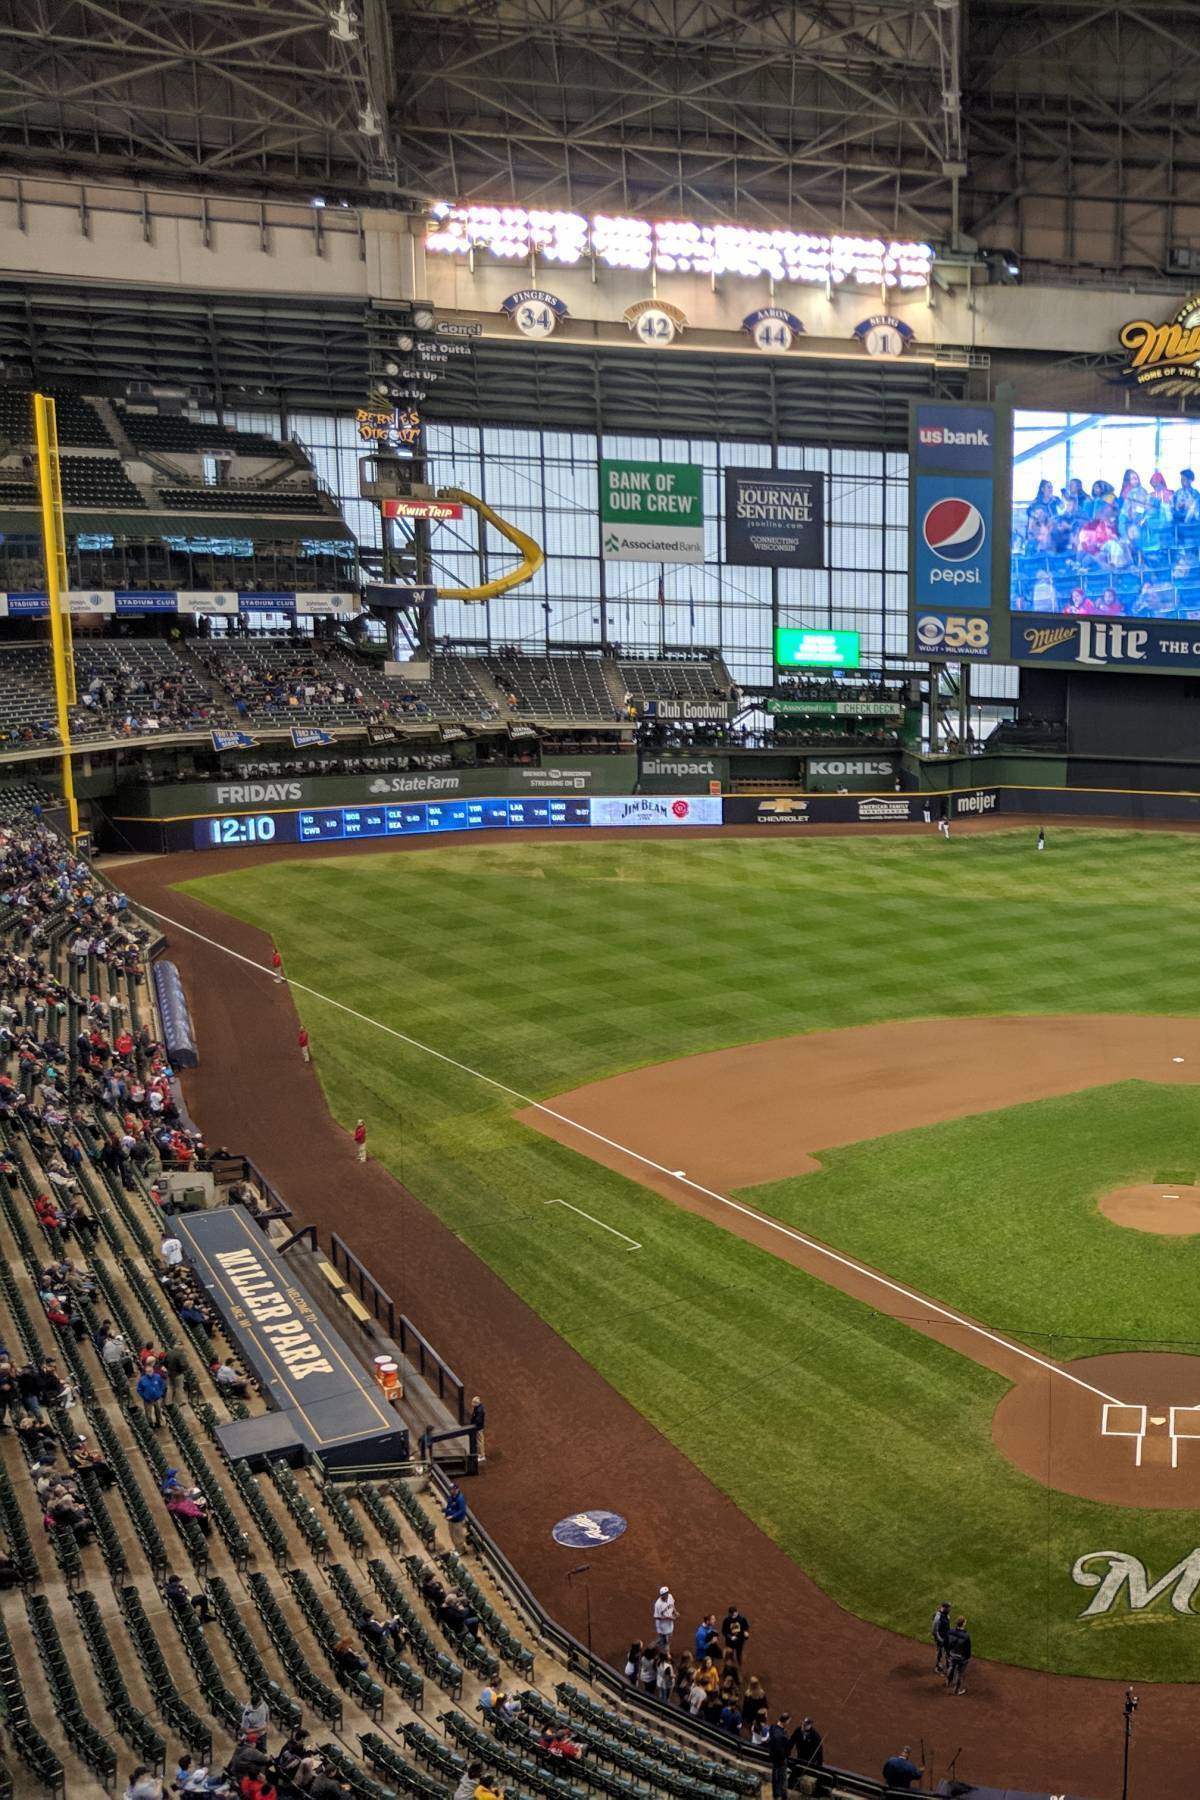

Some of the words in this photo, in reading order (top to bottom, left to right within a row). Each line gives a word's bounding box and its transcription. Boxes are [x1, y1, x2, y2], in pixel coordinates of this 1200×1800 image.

[513, 291, 557, 306] FINGERS
[520, 308, 551, 331] 34
[757, 310, 790, 321] AARON
[870, 316, 898, 328] SELIG
[437, 323, 482, 336] Gone!
[641, 317, 669, 337] 42
[759, 326, 787, 347] 44
[879, 335, 890, 353] 1
[417, 343, 437, 352] Get
[440, 343, 471, 355] Outta
[422, 353, 448, 362] Here
[402, 371, 421, 380] Get
[423, 371, 438, 381] Up
[1138, 369, 1162, 384] HOME
[1164, 367, 1175, 376] OF
[1179, 367, 1195, 377] THE
[391, 389, 409, 398] Get
[411, 390, 426, 399] Up
[609, 471, 651, 491] BANK
[656, 474, 675, 491] OF
[609, 492, 641, 511] OUR
[647, 494, 693, 513] CREW
[737, 489, 812, 507] JOURNAL
[737, 504, 812, 522] SENTINEL
[621, 538, 679, 551] Associated
[680, 541, 702, 552] Bank
[930, 568, 979, 585] pepsi
[9, 600, 39, 608] STADIUM
[944, 617, 989, 647] 58
[945, 647, 988, 655] MILWAUKEE
[1024, 627, 1078, 654] Miller
[1075, 620, 1148, 665] Lite
[1159, 641, 1189, 654] THE
[658, 701, 680, 718] Club
[684, 701, 728, 719] Goodwill
[844, 703, 871, 713] CHECK
[874, 704, 894, 714] DECK
[656, 759, 714, 776] impact
[810, 762, 893, 775] KOHL'S
[217, 783, 302, 804] FRIDAYS
[621, 801, 639, 818] JIM
[641, 799, 667, 817] BEAM
[958, 792, 996, 813] meijer
[212, 817, 275, 843] 12:10
[286, 1287, 312, 1314] WELCOME
[304, 1312, 318, 1322] TO
[216, 1248, 294, 1322] MILLER
[262, 1317, 334, 1380] PARK
